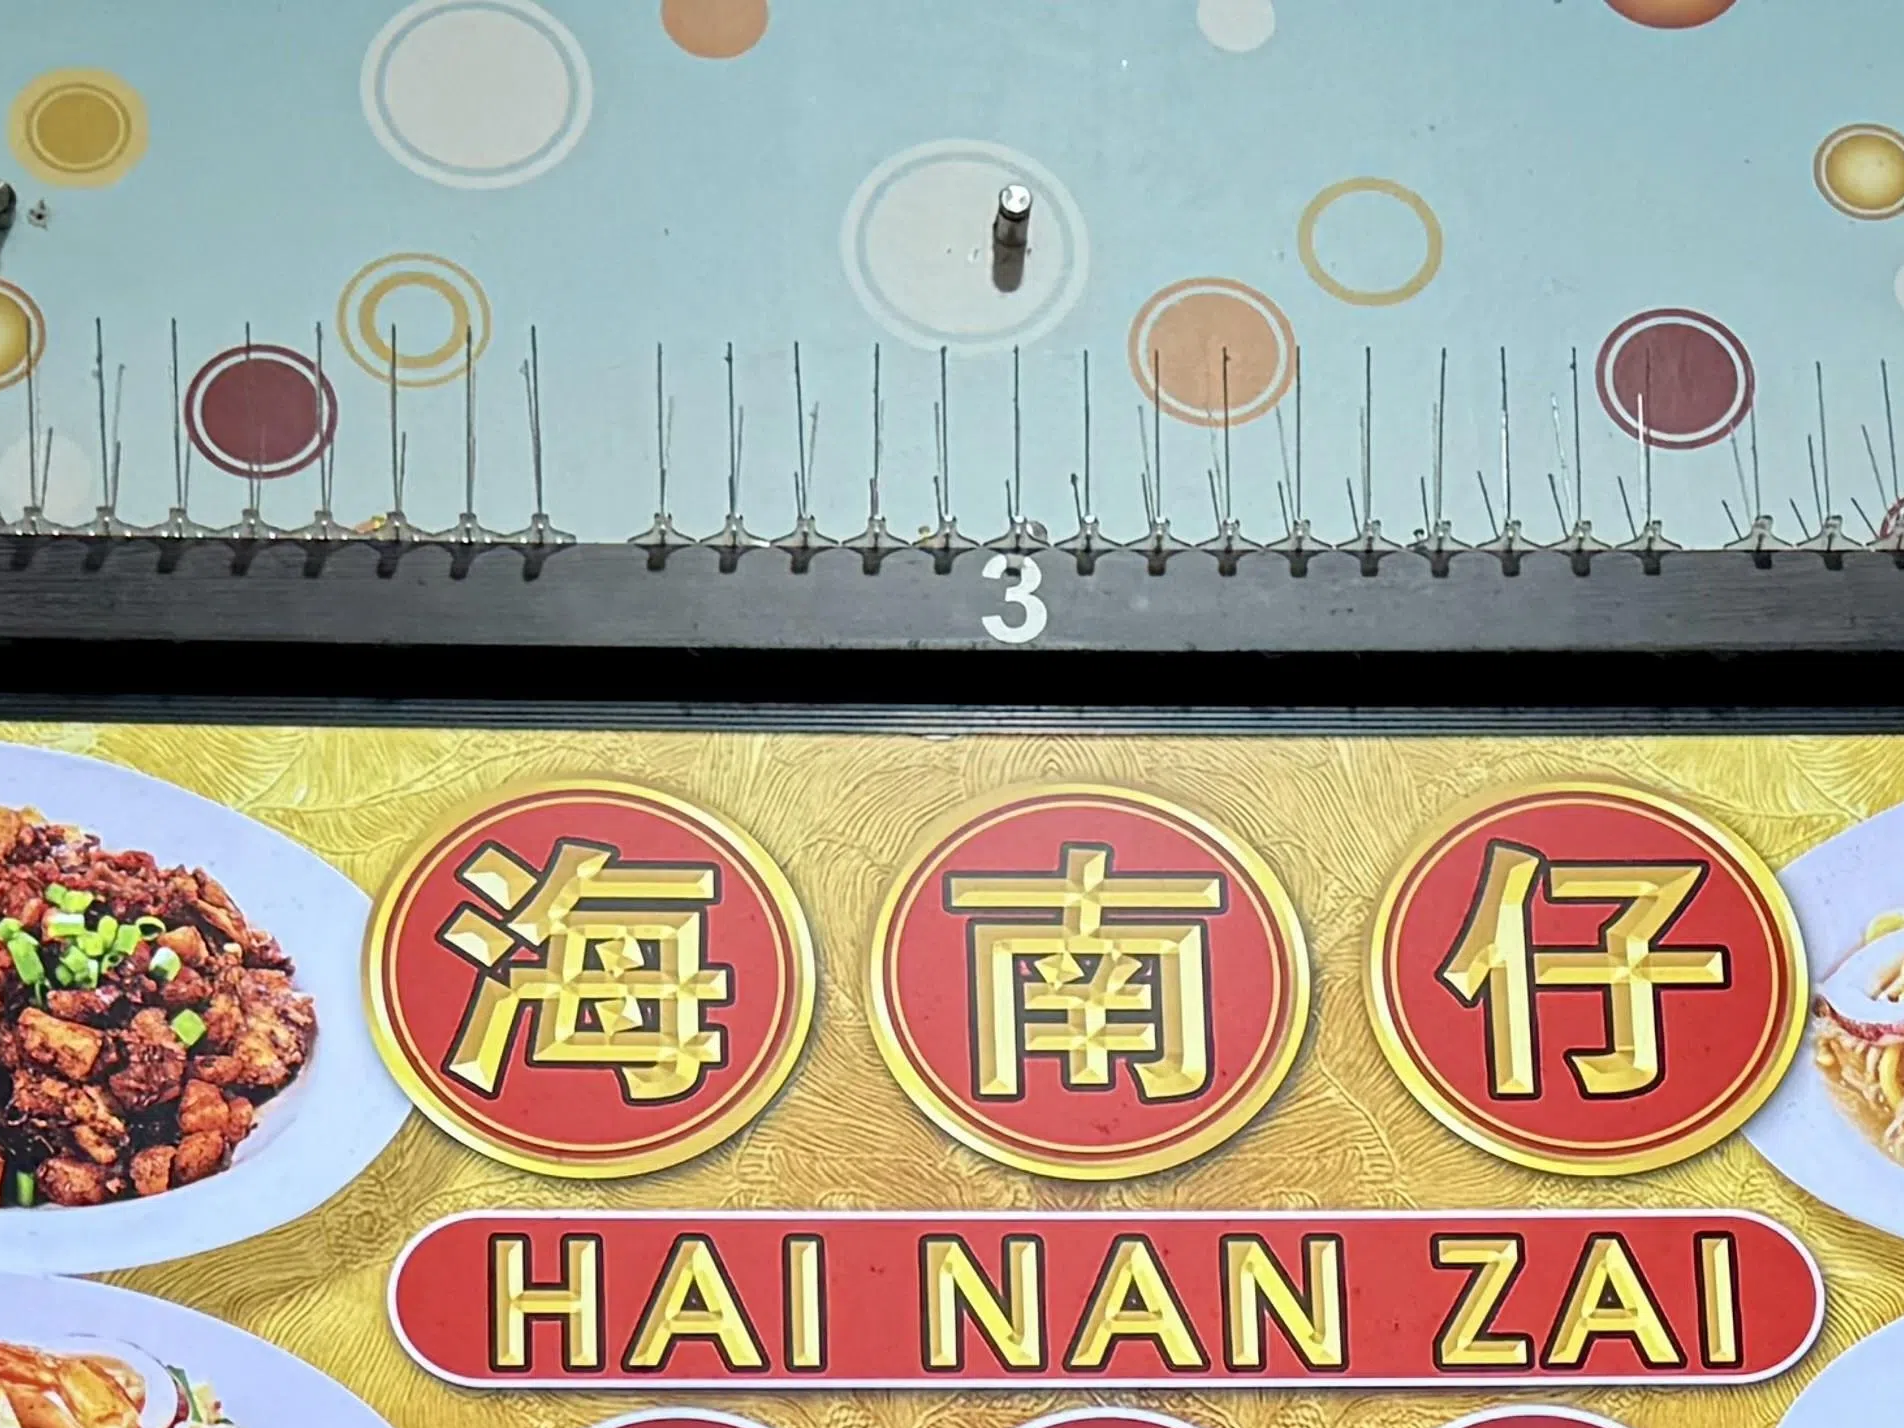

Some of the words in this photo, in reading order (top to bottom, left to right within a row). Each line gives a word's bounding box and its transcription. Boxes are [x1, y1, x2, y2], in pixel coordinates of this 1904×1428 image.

[981, 552, 1048, 644] 3
[440, 837, 1732, 1102] 海南仔
[490, 1228, 827, 1372] HAI
[920, 1228, 1346, 1374] NAN
[1428, 1228, 1746, 1371] ZAI
